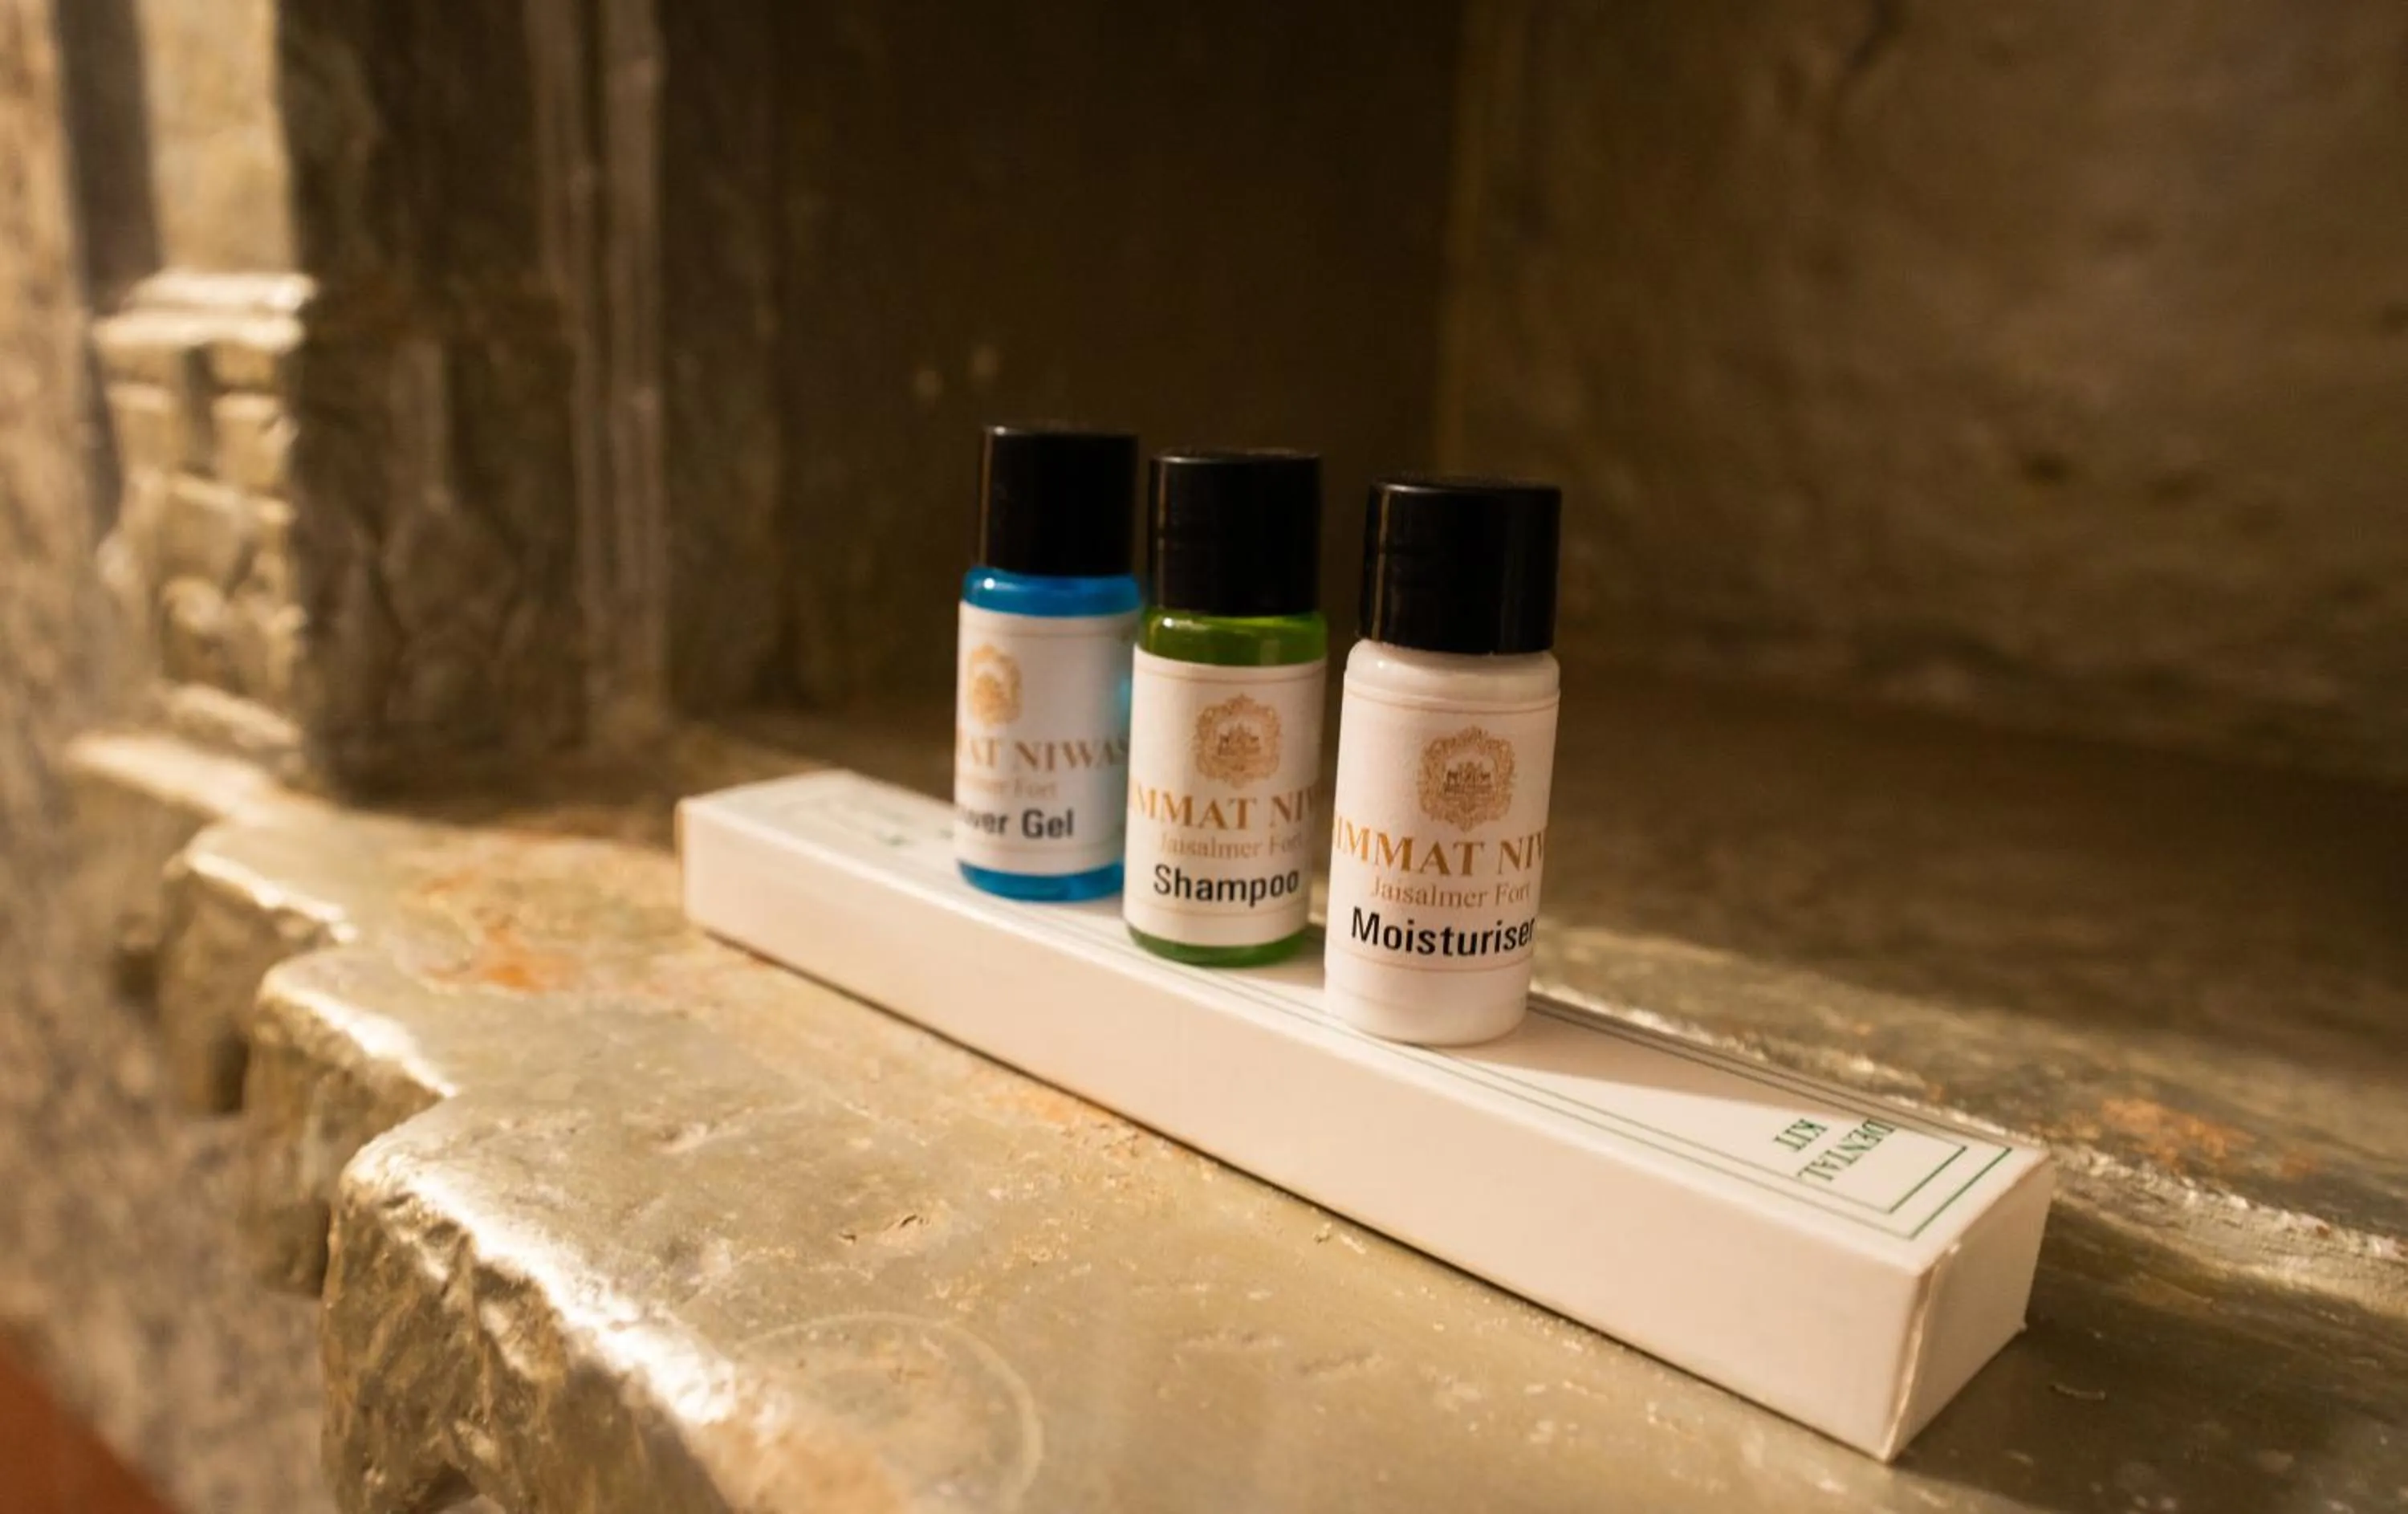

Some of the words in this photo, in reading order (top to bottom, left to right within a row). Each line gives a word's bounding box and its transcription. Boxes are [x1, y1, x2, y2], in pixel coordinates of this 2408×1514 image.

[960, 806, 1009, 835] wer
[1021, 807, 1074, 840] Gel
[1130, 782, 1259, 832] MMAT
[1334, 813, 1485, 877] IMMAT
[1153, 863, 1300, 909] Shampoo
[1369, 874, 1490, 910] Jaisalmer
[1494, 881, 1531, 908] Fort
[1351, 906, 1536, 957] Moisturiser
[1772, 1117, 1829, 1153] KIT
[1796, 1118, 1897, 1182] DENTAL
